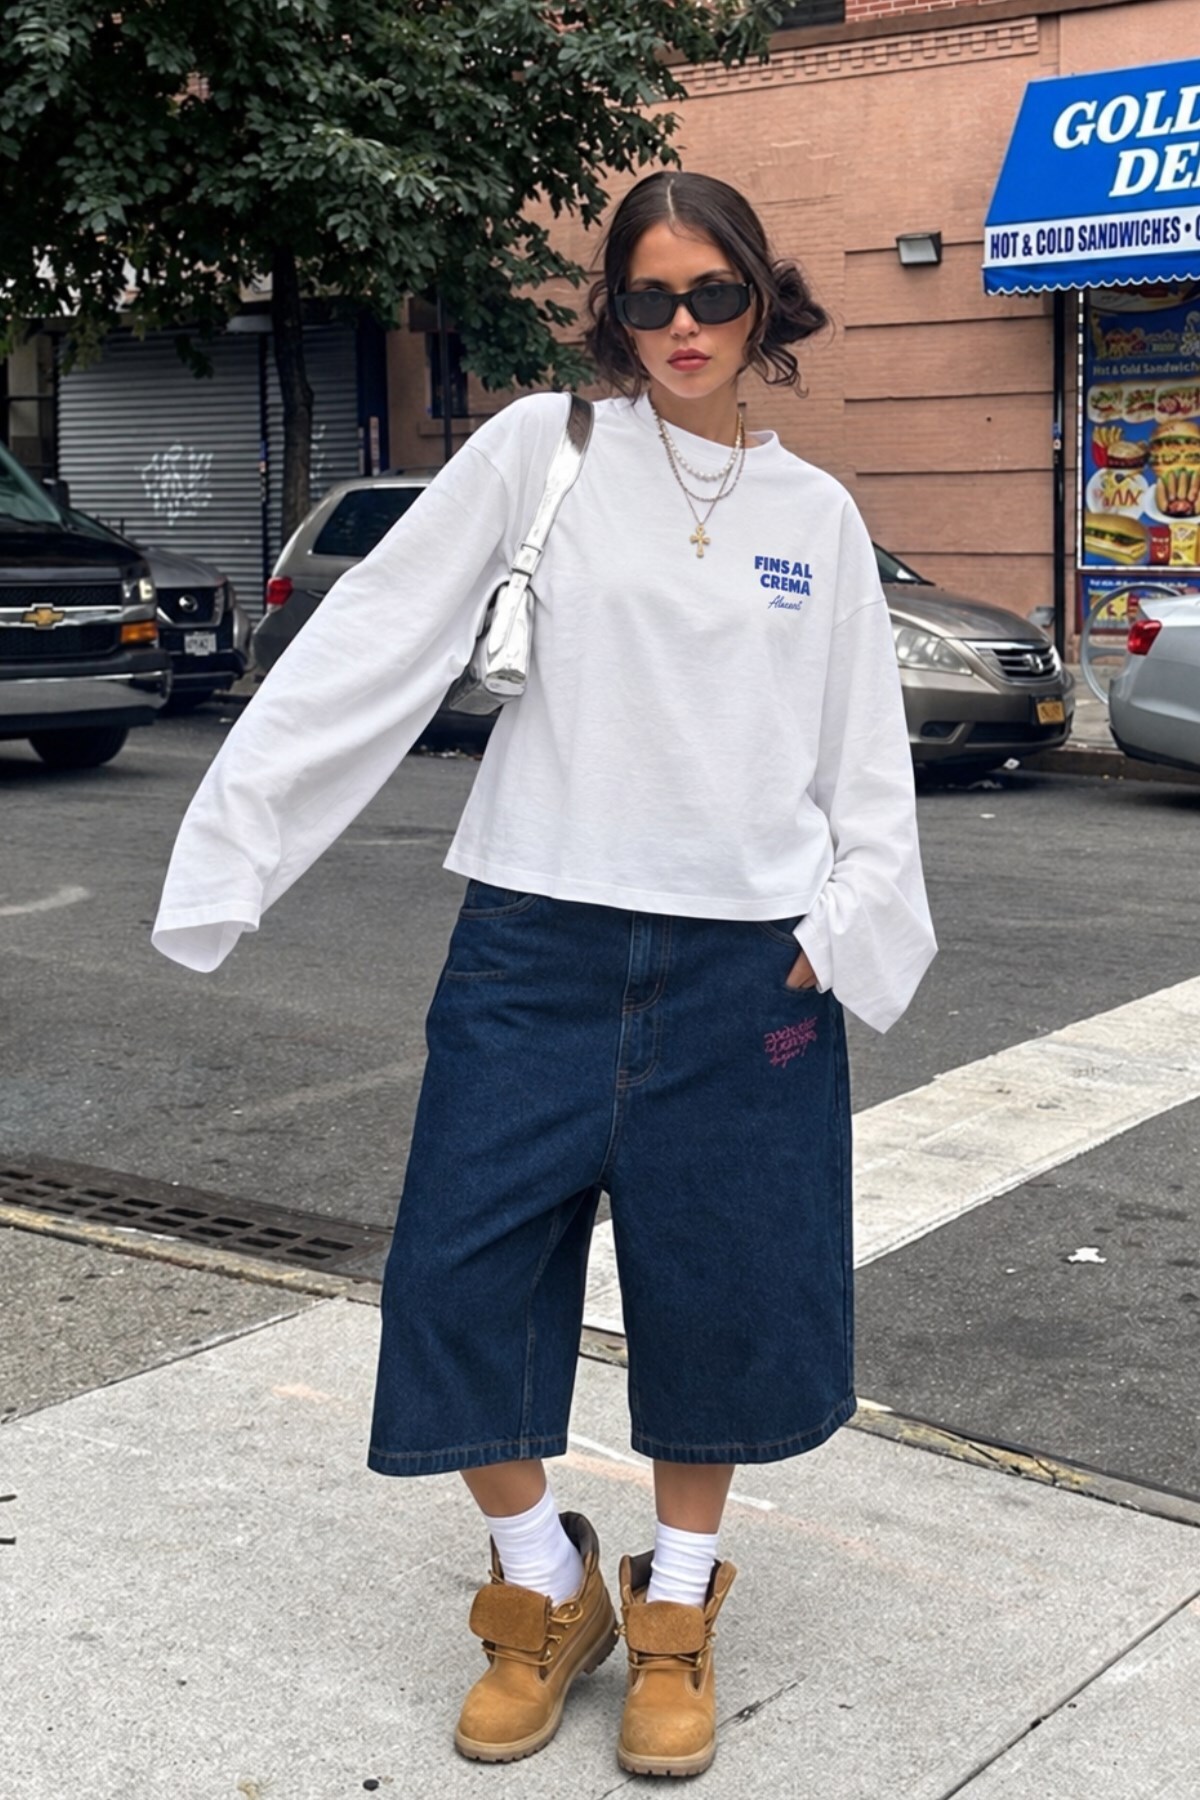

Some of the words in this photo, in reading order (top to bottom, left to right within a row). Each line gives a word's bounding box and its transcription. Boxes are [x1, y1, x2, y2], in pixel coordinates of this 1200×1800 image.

[1108, 141, 1200, 197] DE
[990, 231, 1019, 259] HOT
[1022, 234, 1033, 256] &
[1036, 226, 1075, 256] COLD
[1078, 216, 1181, 252] SANDWICHES
[760, 573, 811, 596] CREMA
